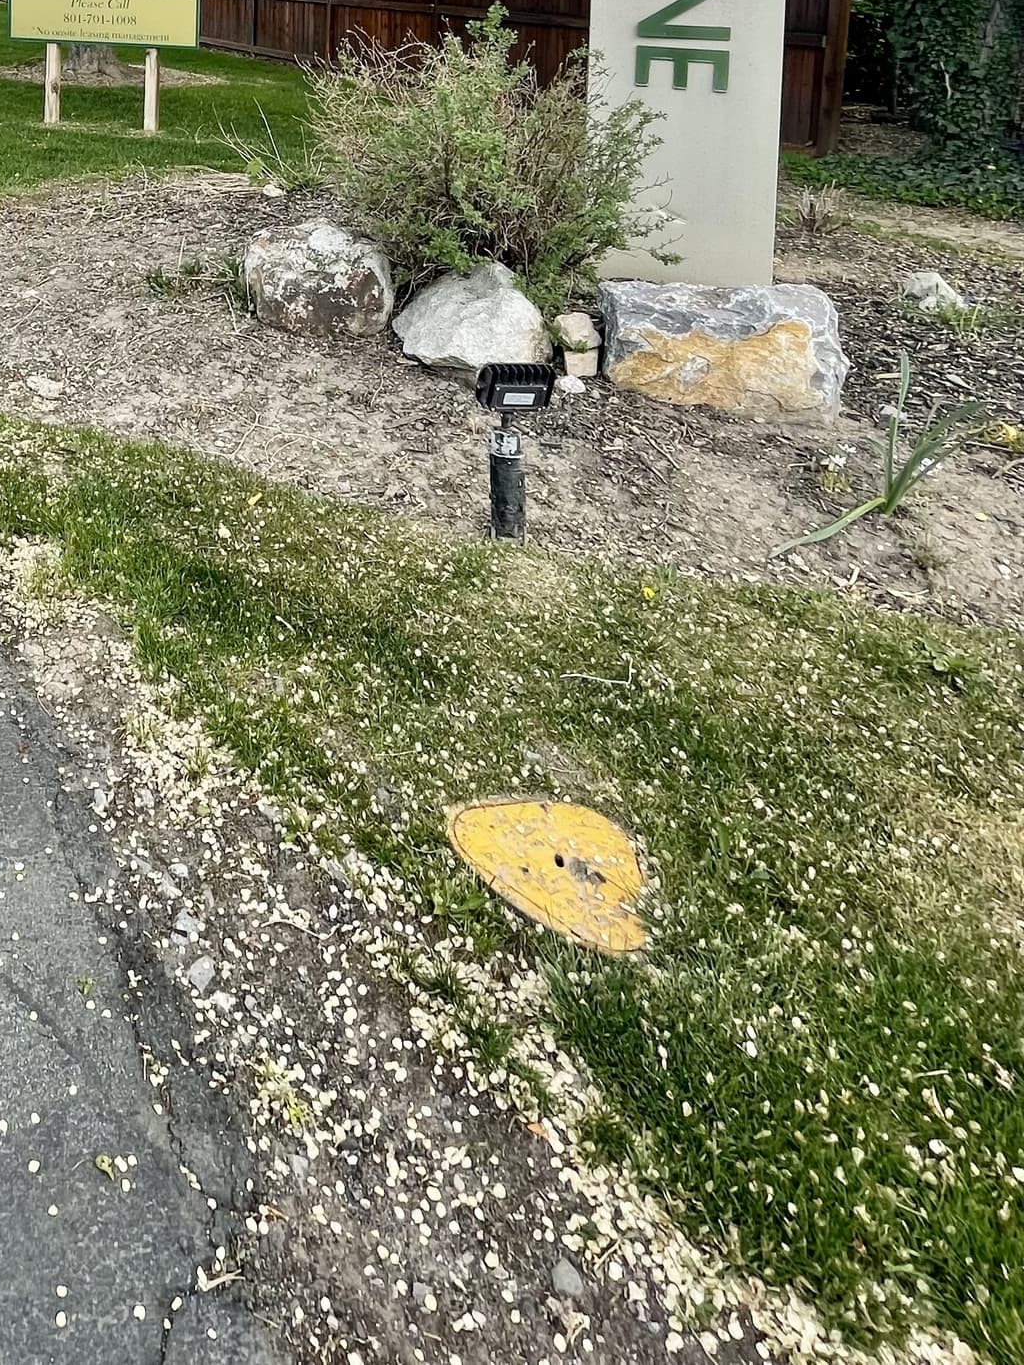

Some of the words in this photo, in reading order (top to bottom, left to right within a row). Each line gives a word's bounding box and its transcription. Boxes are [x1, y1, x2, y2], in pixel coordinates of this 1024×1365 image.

[63, 13, 137, 26] 801-701-1008
[80, 28, 110, 40] leasing
[112, 31, 170, 42] management
